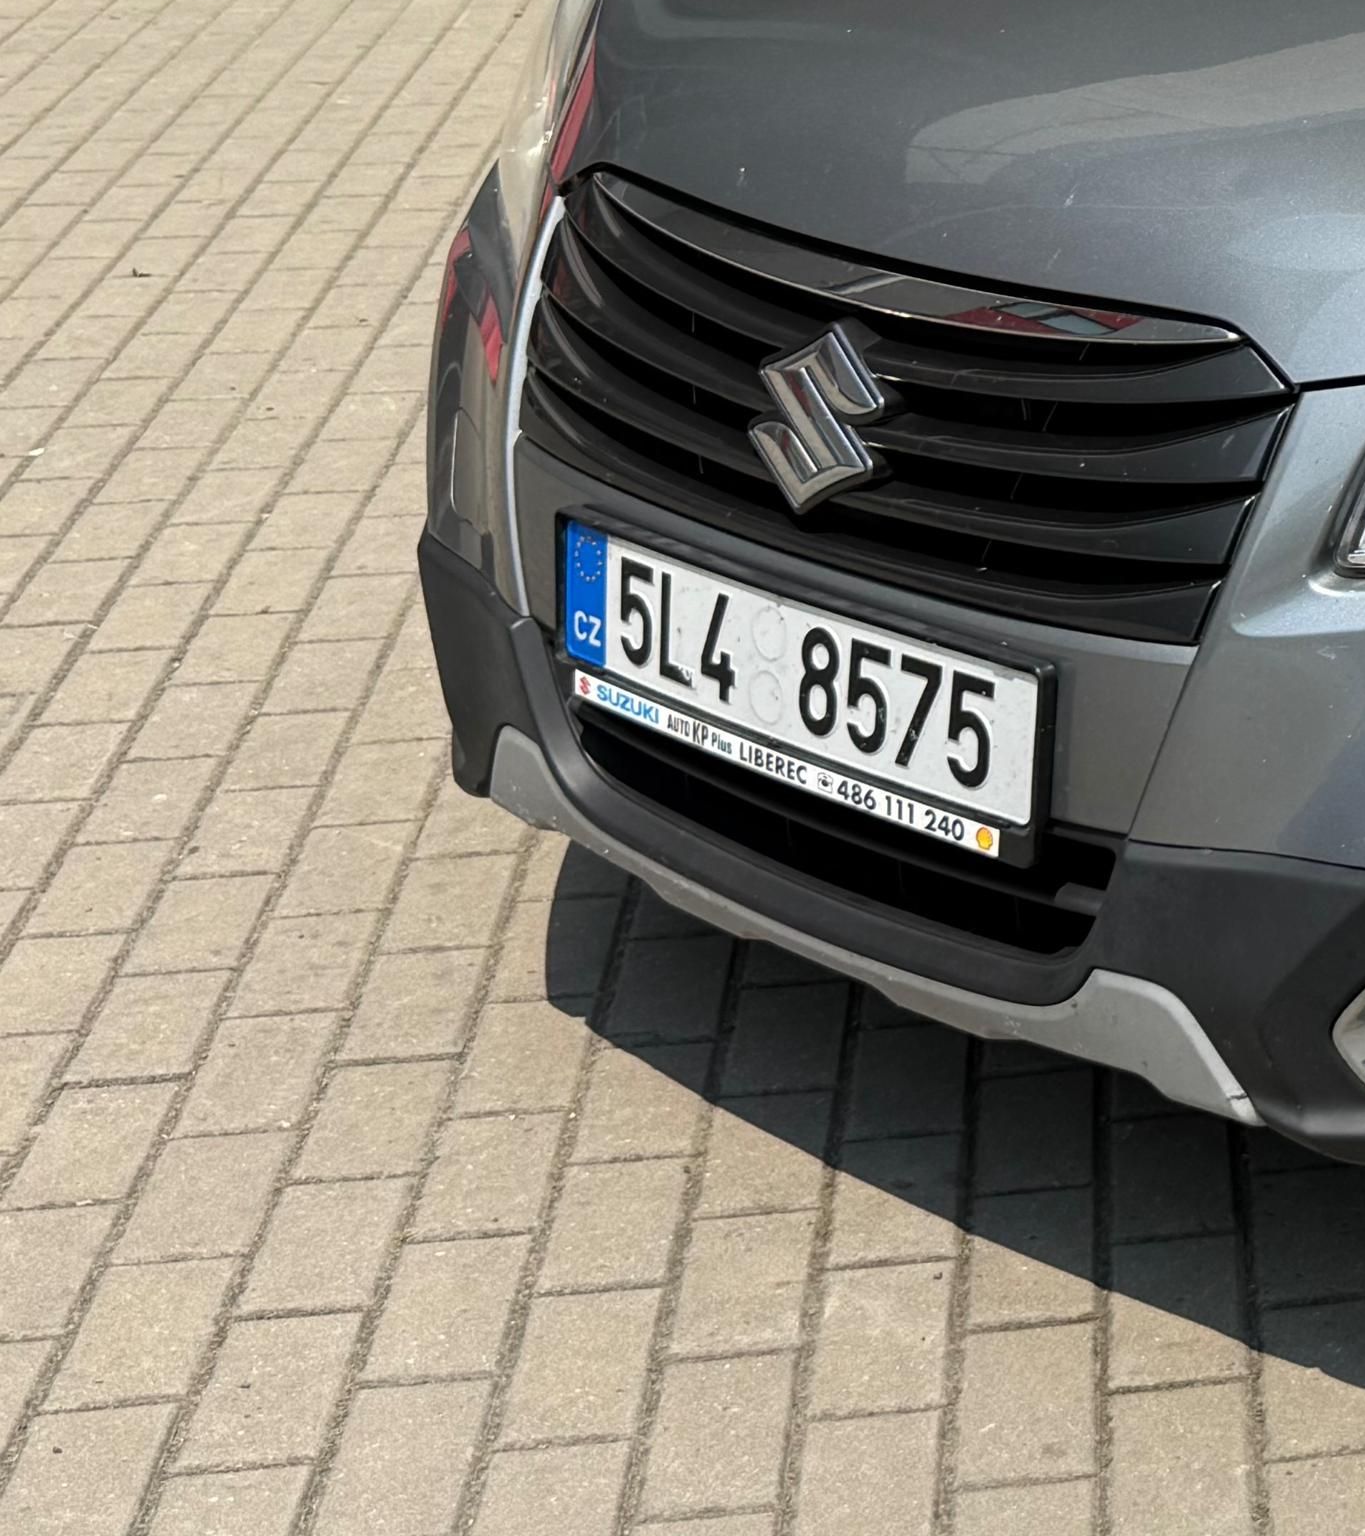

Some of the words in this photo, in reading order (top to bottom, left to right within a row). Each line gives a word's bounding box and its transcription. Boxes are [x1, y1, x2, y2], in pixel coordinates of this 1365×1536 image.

[574, 609, 602, 647] CZ
[620, 556, 736, 704] 5L4
[800, 627, 996, 788] 8575
[596, 685, 660, 724] SUZUKI
[667, 714, 690, 737] AUTO
[692, 721, 709, 746] KP
[711, 732, 732, 754] Plus
[739, 742, 808, 784] LIBEREC
[837, 780, 877, 810] 486
[885, 795, 915, 824] 111
[924, 809, 965, 841] 240
